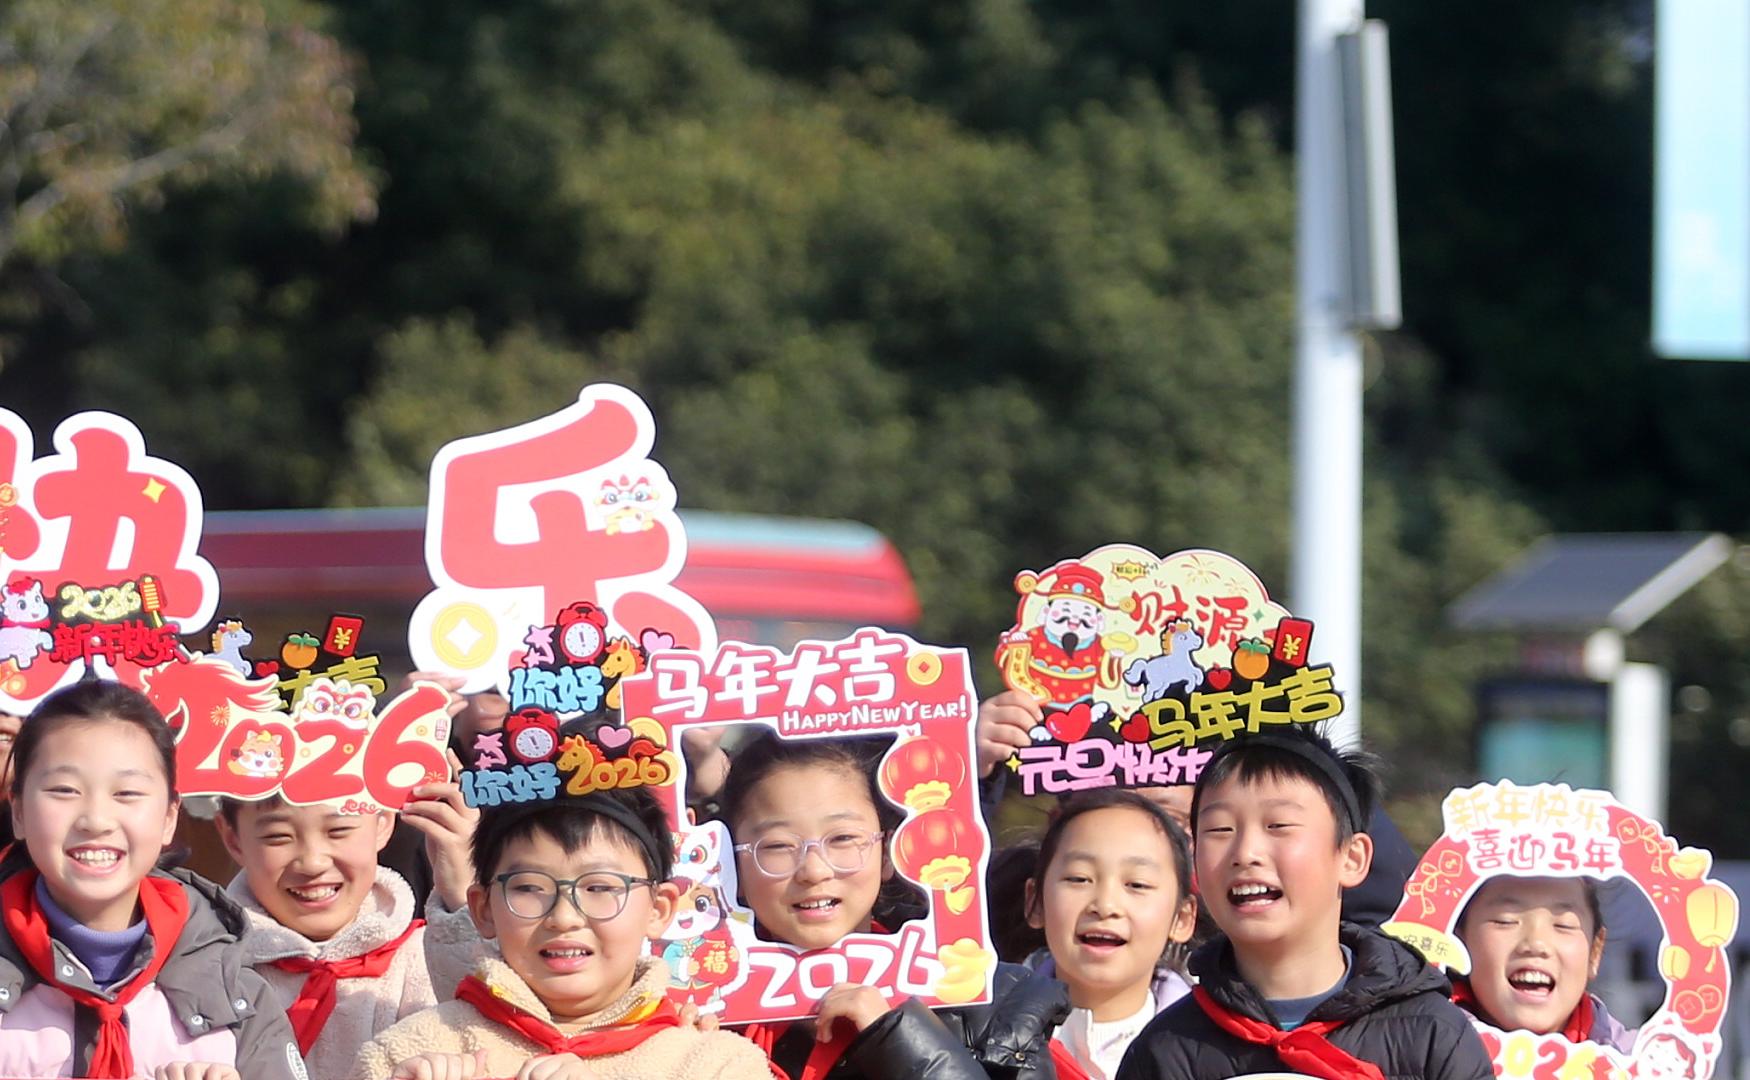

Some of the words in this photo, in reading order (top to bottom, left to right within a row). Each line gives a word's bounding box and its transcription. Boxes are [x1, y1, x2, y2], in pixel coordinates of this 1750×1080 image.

[435, 396, 698, 690] 乐
[60, 581, 142, 621] 2026
[49, 619, 189, 667] 新年快乐
[651, 636, 903, 720] 马年大吉
[148, 652, 450, 811] 2026
[1141, 666, 1343, 750] 马年大吉
[460, 762, 561, 808] 你好
[1018, 737, 1215, 797] 元旦快乐
[1446, 786, 1608, 835] 新年快乐
[1470, 827, 1616, 874] 喜迎马年
[703, 950, 729, 974] 福
[749, 929, 948, 1009] 2026
